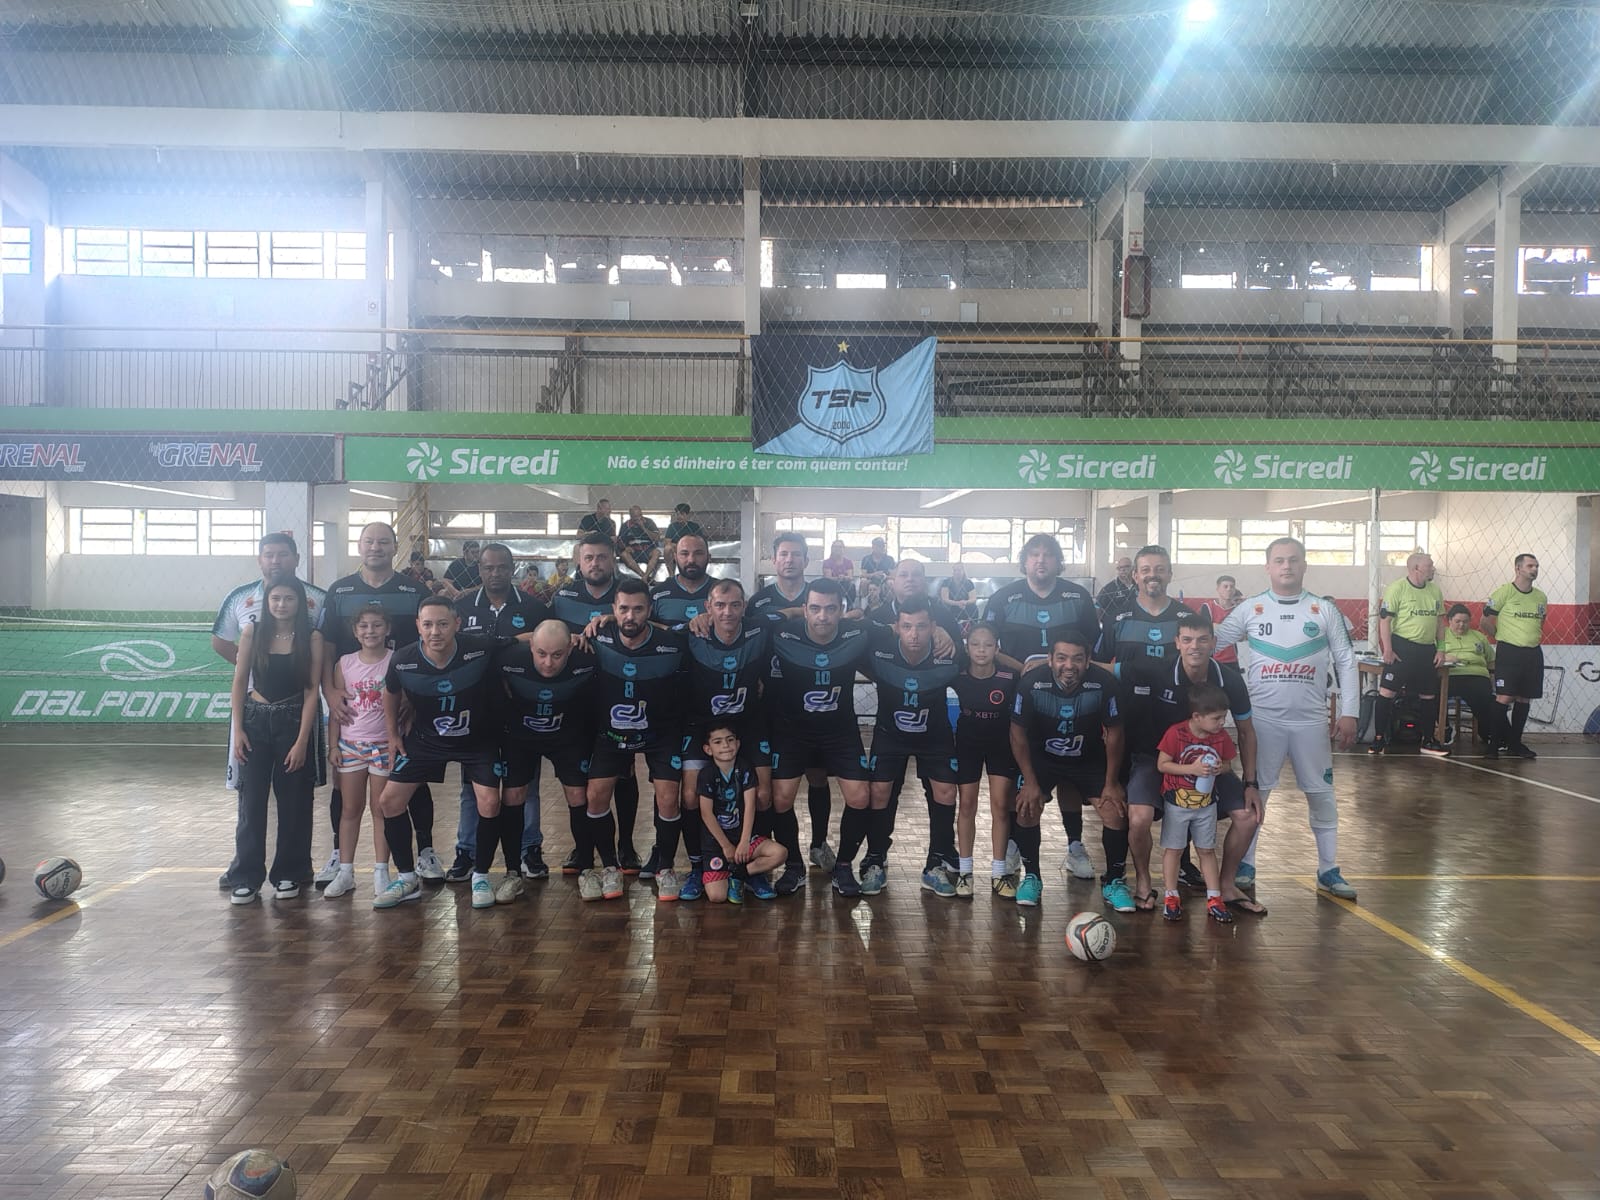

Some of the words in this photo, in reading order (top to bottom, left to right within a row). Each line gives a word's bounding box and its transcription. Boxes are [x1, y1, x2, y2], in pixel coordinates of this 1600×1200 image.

[811, 389, 872, 409] TSF
[0, 443, 86, 468] RENAL
[159, 442, 263, 468] GRENAL
[449, 448, 560, 476] Sicredi
[607, 456, 637, 469] Não
[640, 456, 649, 469] é
[652, 456, 671, 470] só
[673, 456, 736, 470] dinheiro
[739, 456, 749, 470] é
[751, 458, 773, 470] ter
[776, 460, 806, 470] com
[810, 460, 850, 473] quem
[854, 459, 909, 471] contar!
[1056, 454, 1157, 479] Sicredi
[1252, 454, 1353, 480] Sicredi
[1448, 456, 1547, 481] Sicredi
[1041, 629, 1049, 647] 1
[1258, 622, 1273, 636] 30
[815, 670, 831, 686] 10
[1261, 663, 1316, 677] AVENIDA
[624, 681, 634, 698] 8
[723, 672, 737, 689] 17
[11, 690, 233, 718] DALPONTE
[903, 691, 919, 708] 14
